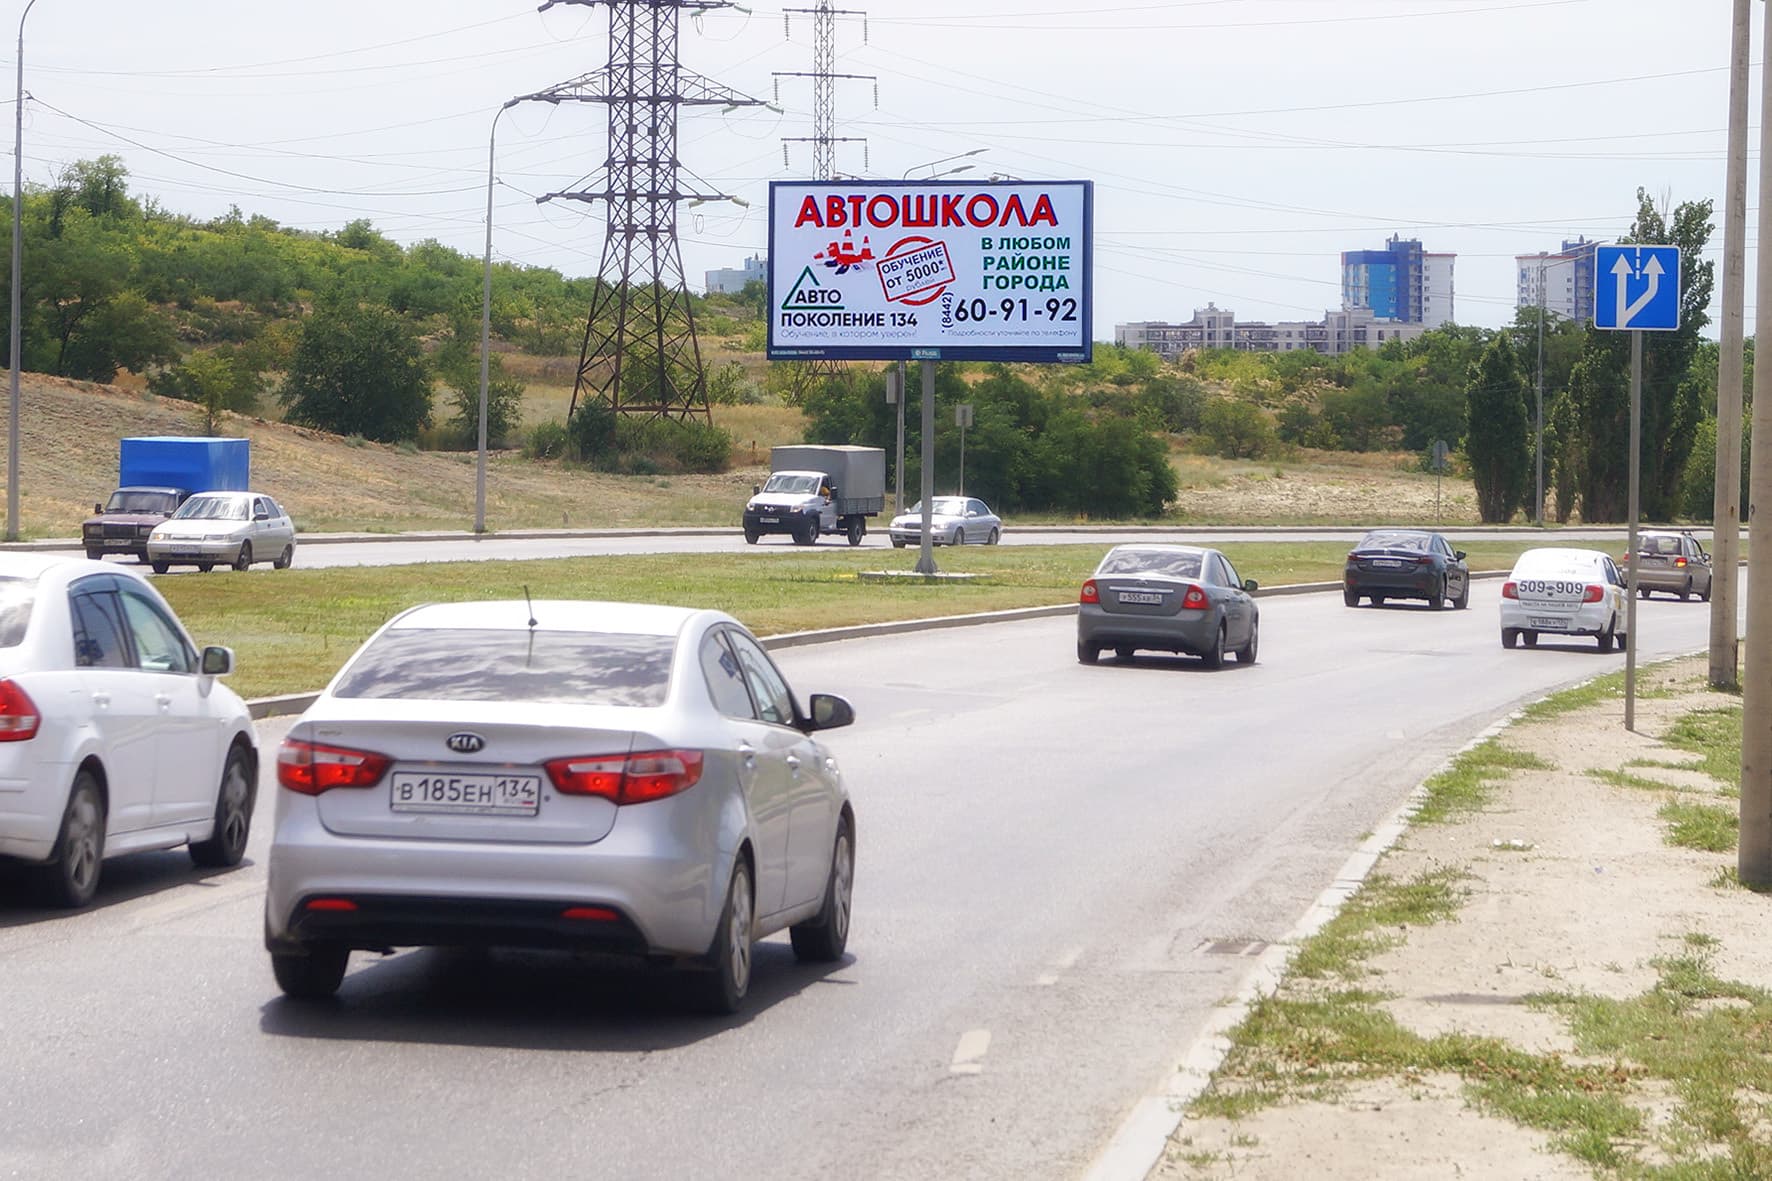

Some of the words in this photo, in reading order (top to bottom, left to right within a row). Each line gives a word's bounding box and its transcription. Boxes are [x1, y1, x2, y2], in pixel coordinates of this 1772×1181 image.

[794, 193, 1059, 228] АВТОШКОЛА
[981, 237, 993, 250] В
[998, 237, 1071, 250] ЛЮБОМ
[881, 246, 944, 274] ОБУЧЕНИЕ
[983, 252, 1070, 271] РАЙОНЕ
[983, 275, 1070, 293] ГОРОДА
[794, 289, 842, 304] АВТО
[781, 312, 885, 327] ПОКОЛЕНИЕ
[889, 313, 918, 327] 134
[941, 292, 955, 329] (8442)
[954, 298, 1078, 322] 60-91-92
[839, 331, 879, 340] котором
[449, 734, 481, 750] KIA
[497, 778, 535, 798] 134
